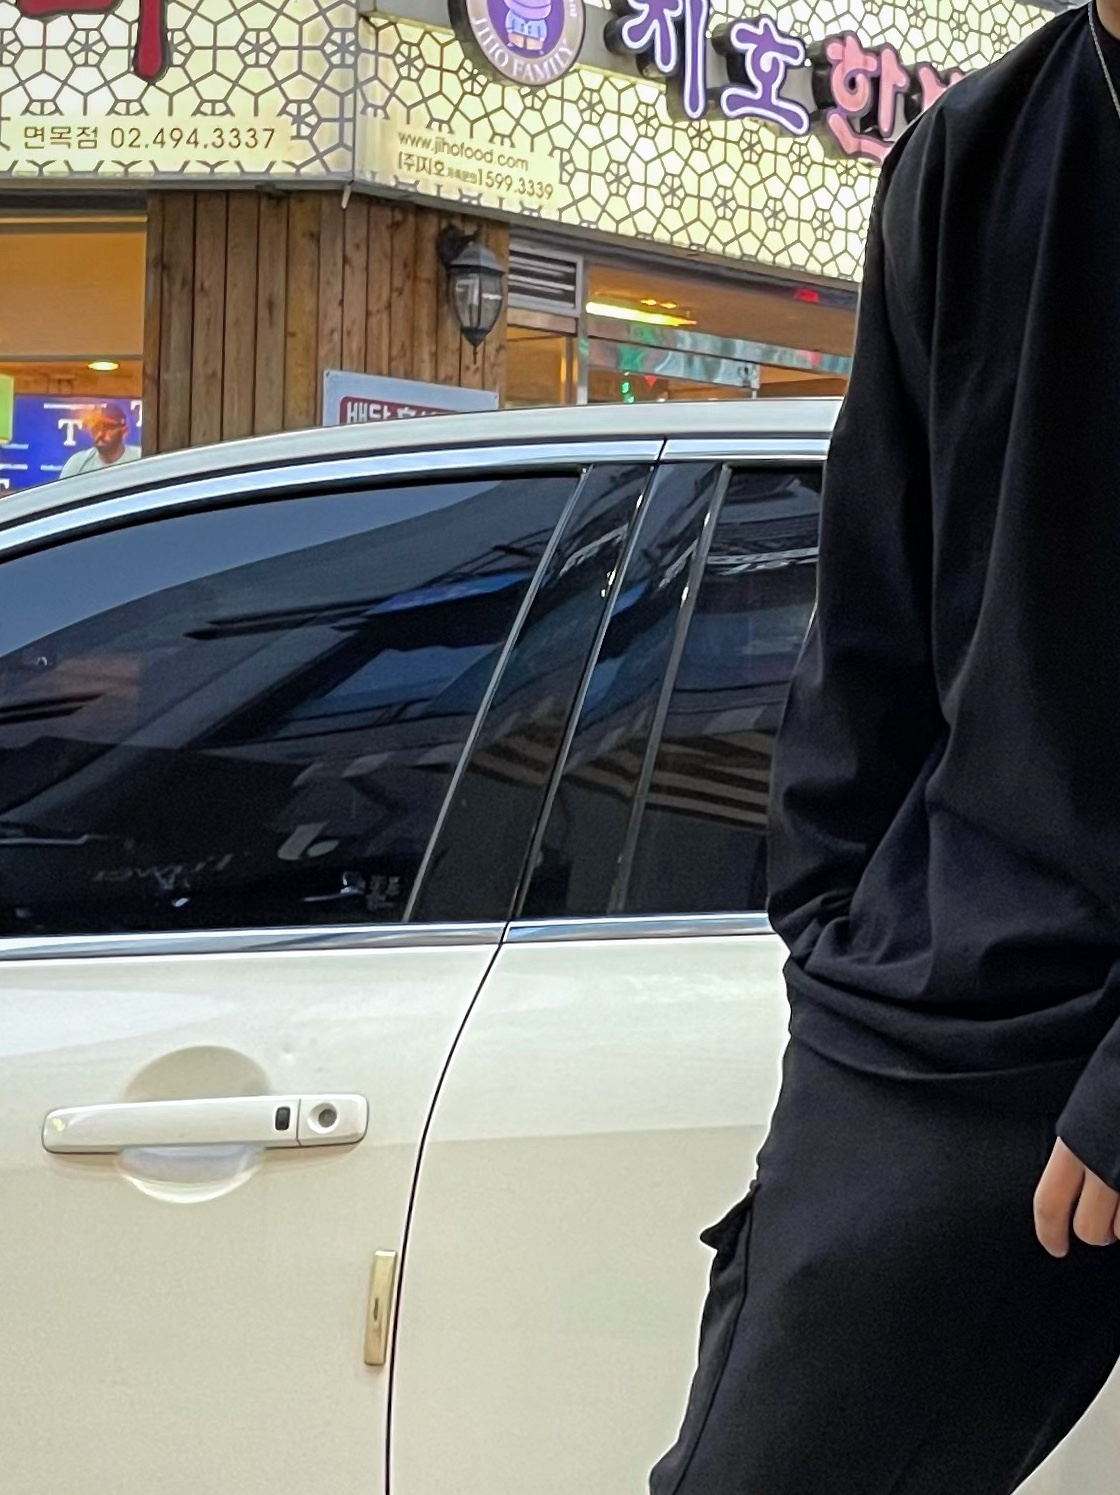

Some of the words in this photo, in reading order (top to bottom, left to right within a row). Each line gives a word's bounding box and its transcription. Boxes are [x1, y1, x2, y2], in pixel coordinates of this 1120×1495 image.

[23, 125, 99, 150] 면목점
[110, 126, 276, 149] 02.494.3337
[397, 131, 530, 172] www.jihofood.com
[478, 168, 555, 200] 1599.3339
